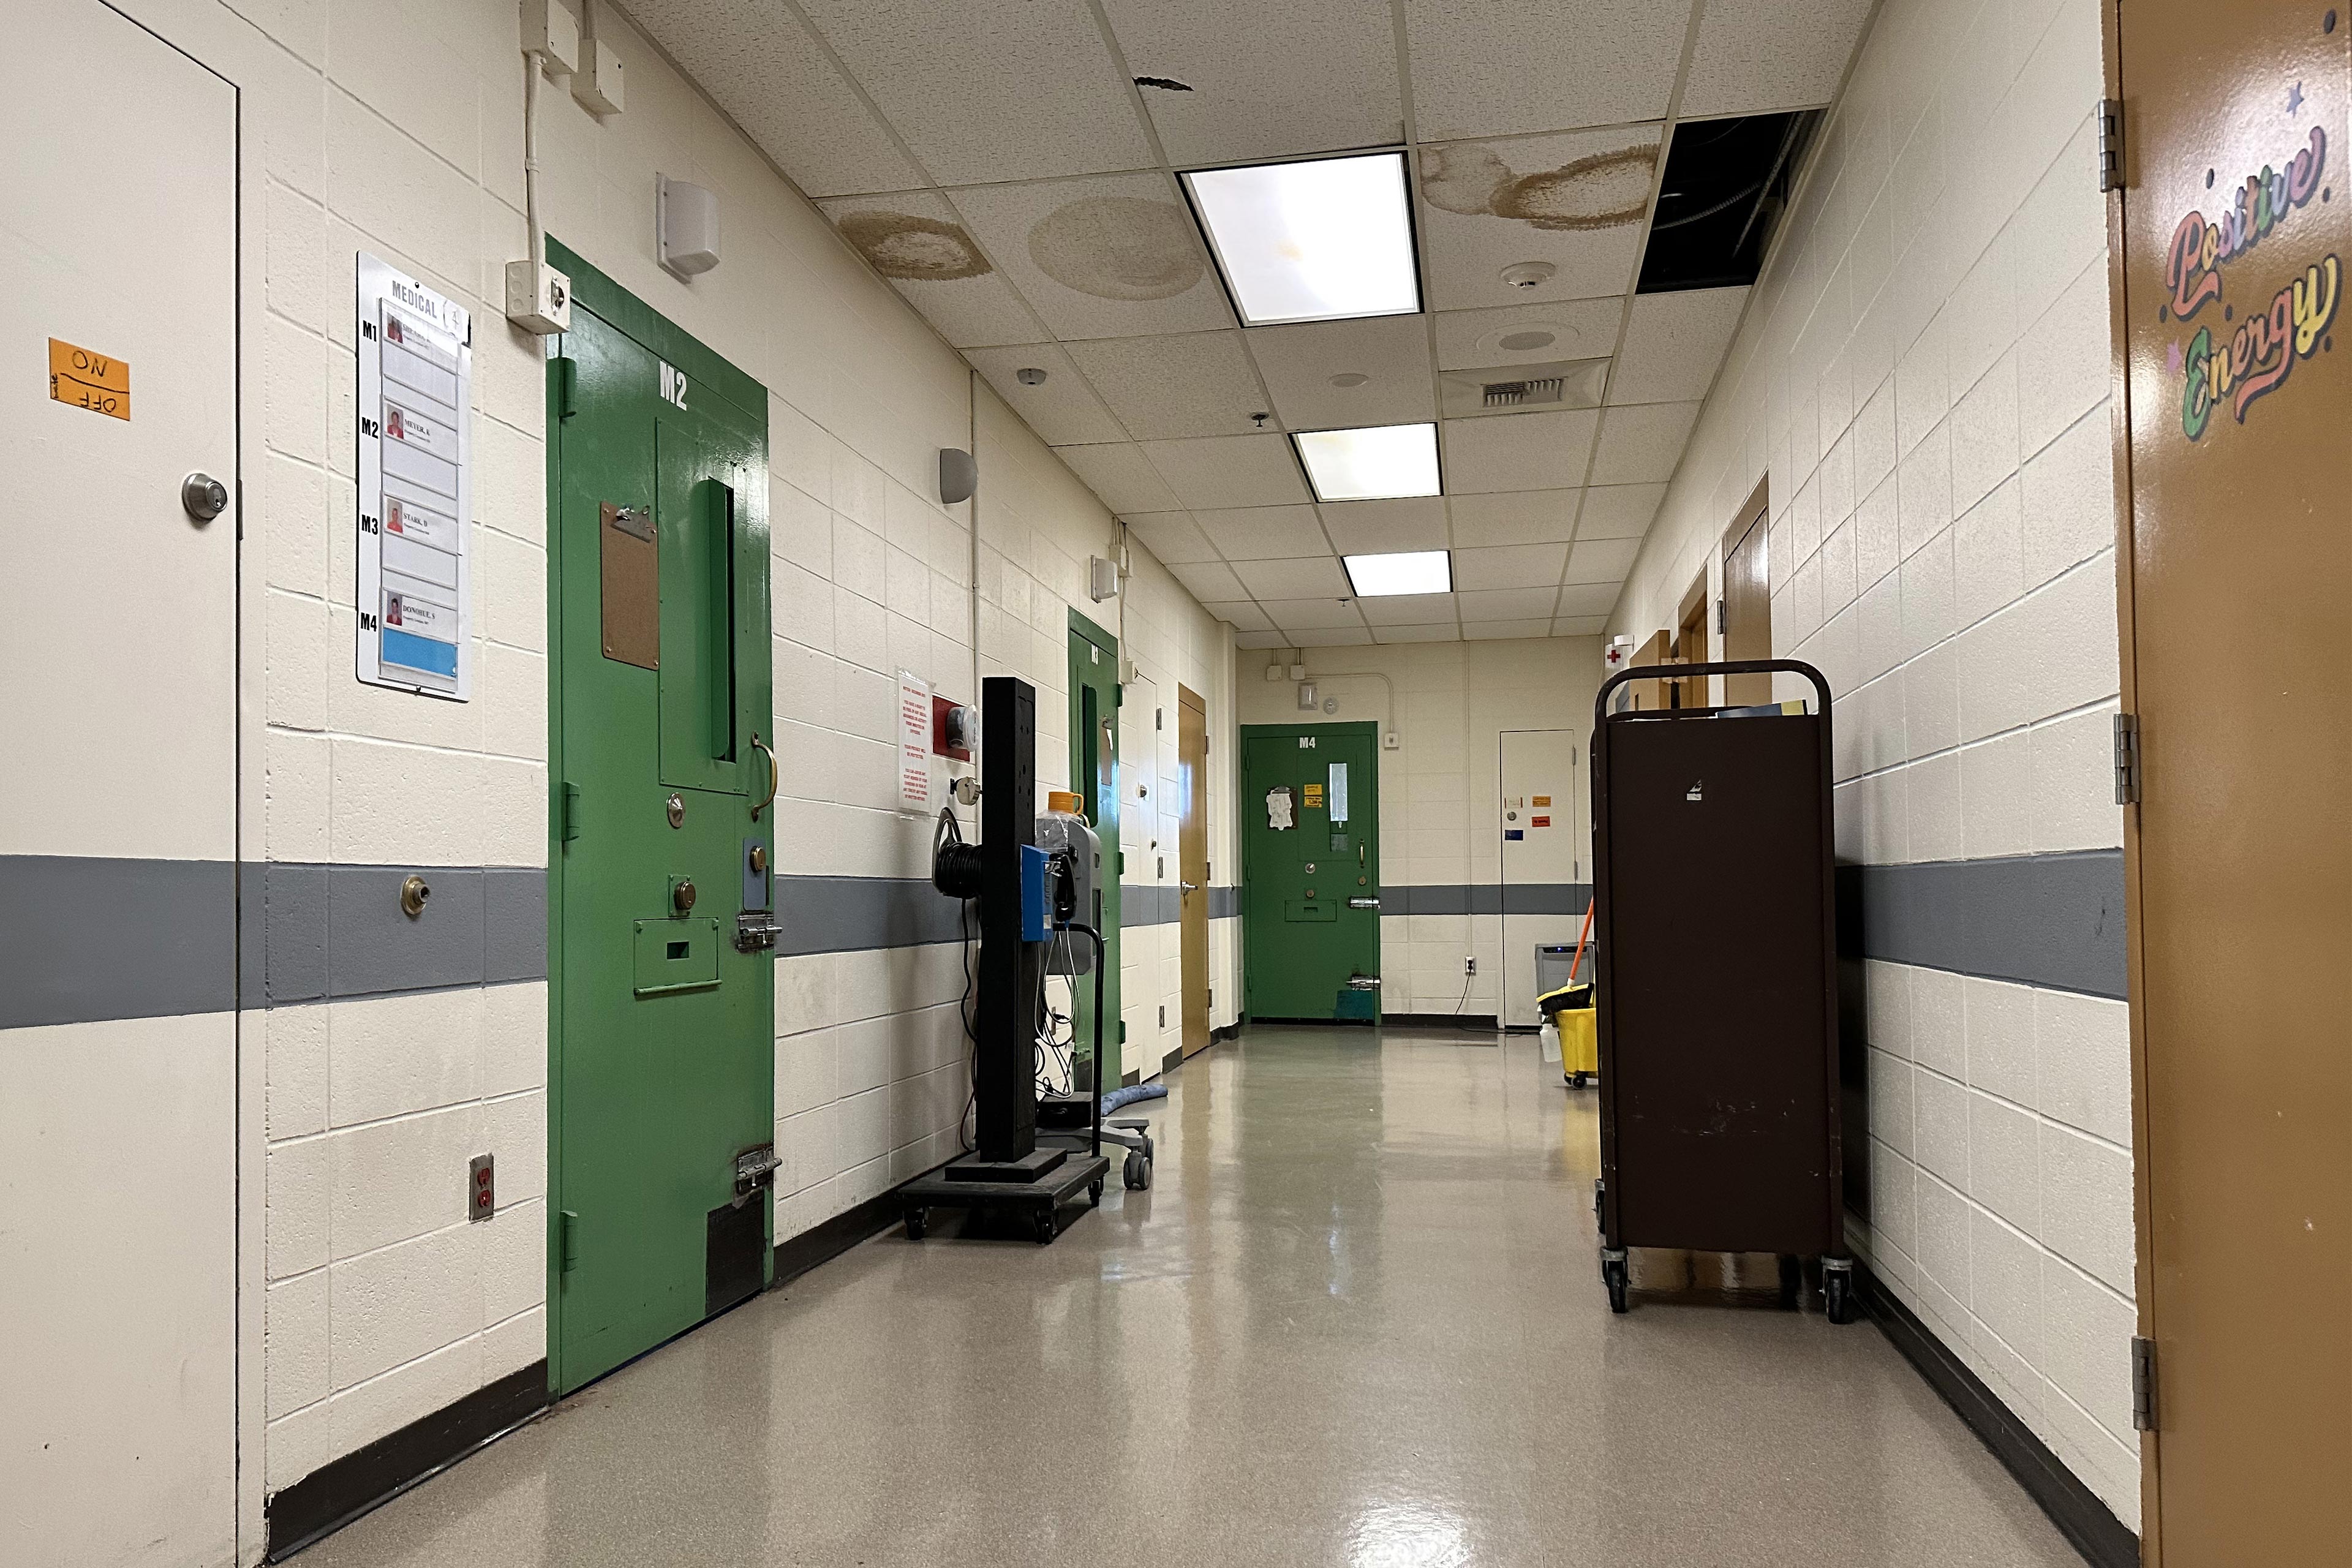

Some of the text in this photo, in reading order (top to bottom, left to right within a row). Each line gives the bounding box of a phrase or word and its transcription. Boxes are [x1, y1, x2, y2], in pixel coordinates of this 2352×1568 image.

[2166, 126, 2326, 322] Positive
[392, 280, 437, 319] MEDICAL
[363, 319, 377, 342] M1
[2182, 253, 2342, 442] Energy
[72, 350, 108, 377] ON
[659, 360, 687, 412] M2
[79, 391, 116, 413] OFF
[361, 417, 379, 439] M2
[361, 514, 378, 535] M3
[360, 612, 377, 632] M4
[1298, 737, 1316, 748] M4
